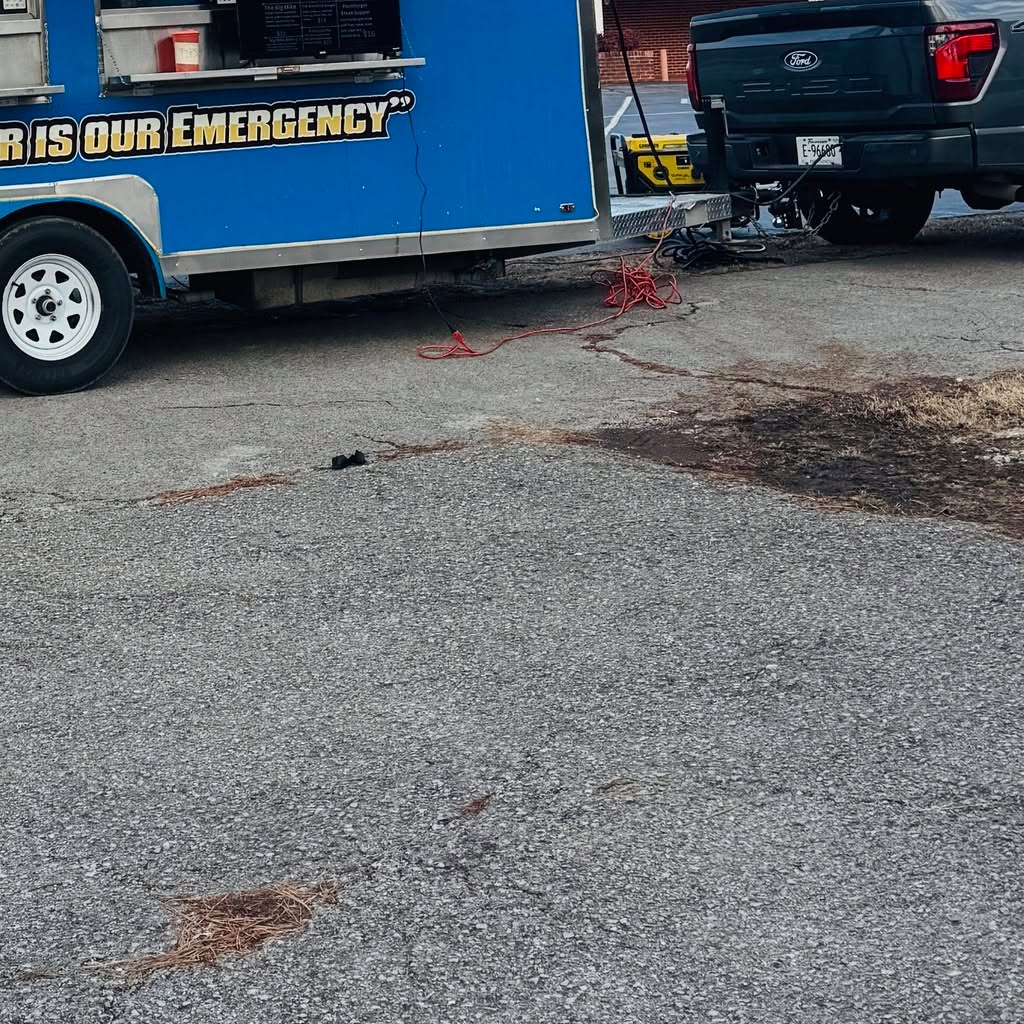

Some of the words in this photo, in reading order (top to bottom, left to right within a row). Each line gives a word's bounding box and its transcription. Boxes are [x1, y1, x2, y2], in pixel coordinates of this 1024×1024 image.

[789, 52, 812, 66] Ford
[34, 123, 74, 159] IS
[83, 117, 162, 155] OUR
